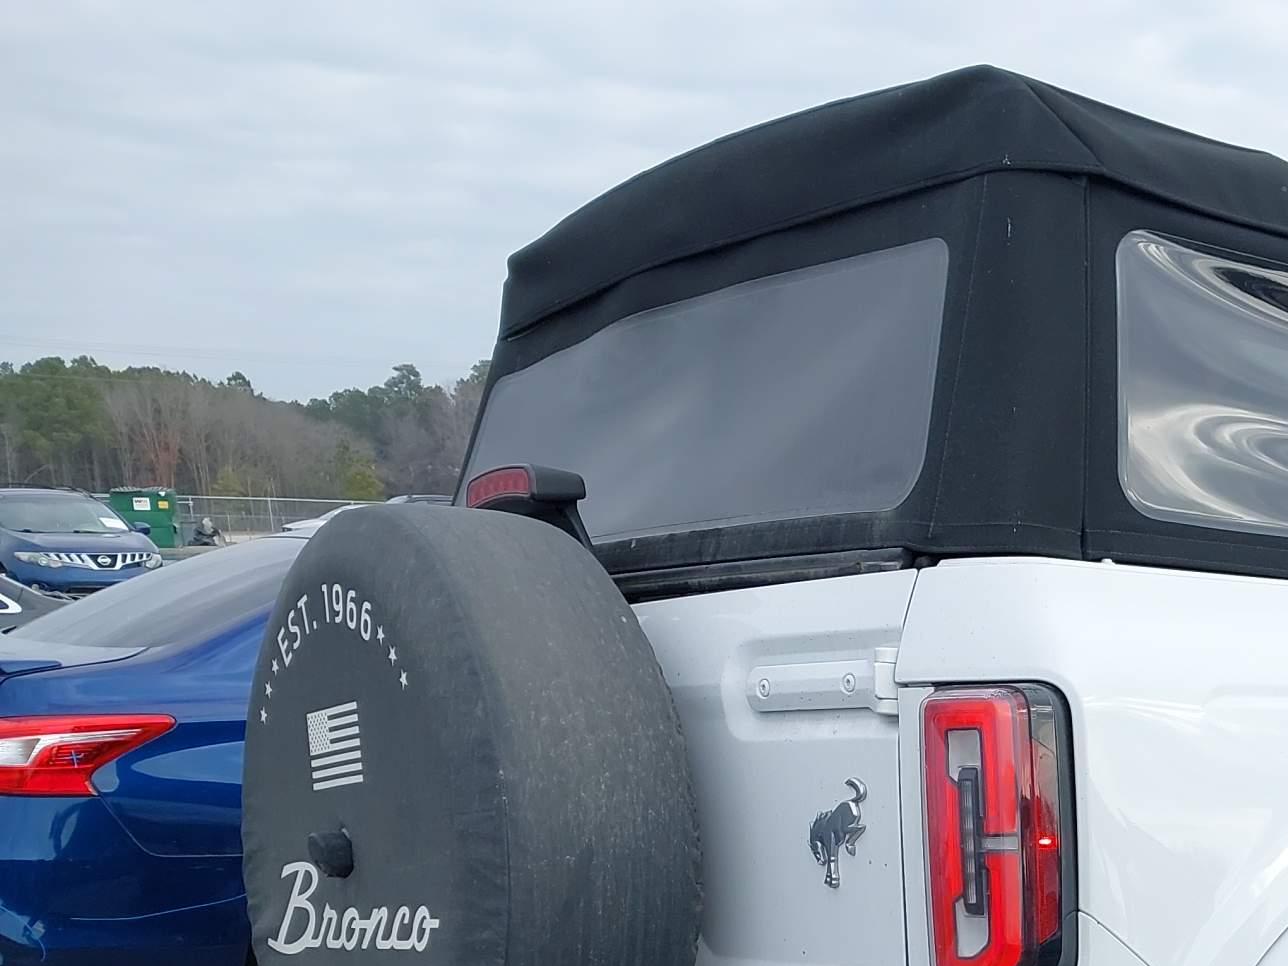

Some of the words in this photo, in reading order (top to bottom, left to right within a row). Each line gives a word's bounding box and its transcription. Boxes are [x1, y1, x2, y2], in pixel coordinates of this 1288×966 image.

[277, 593, 317, 668] EST.
[321, 583, 372, 641] 1966
[268, 861, 439, 955] Bronco
